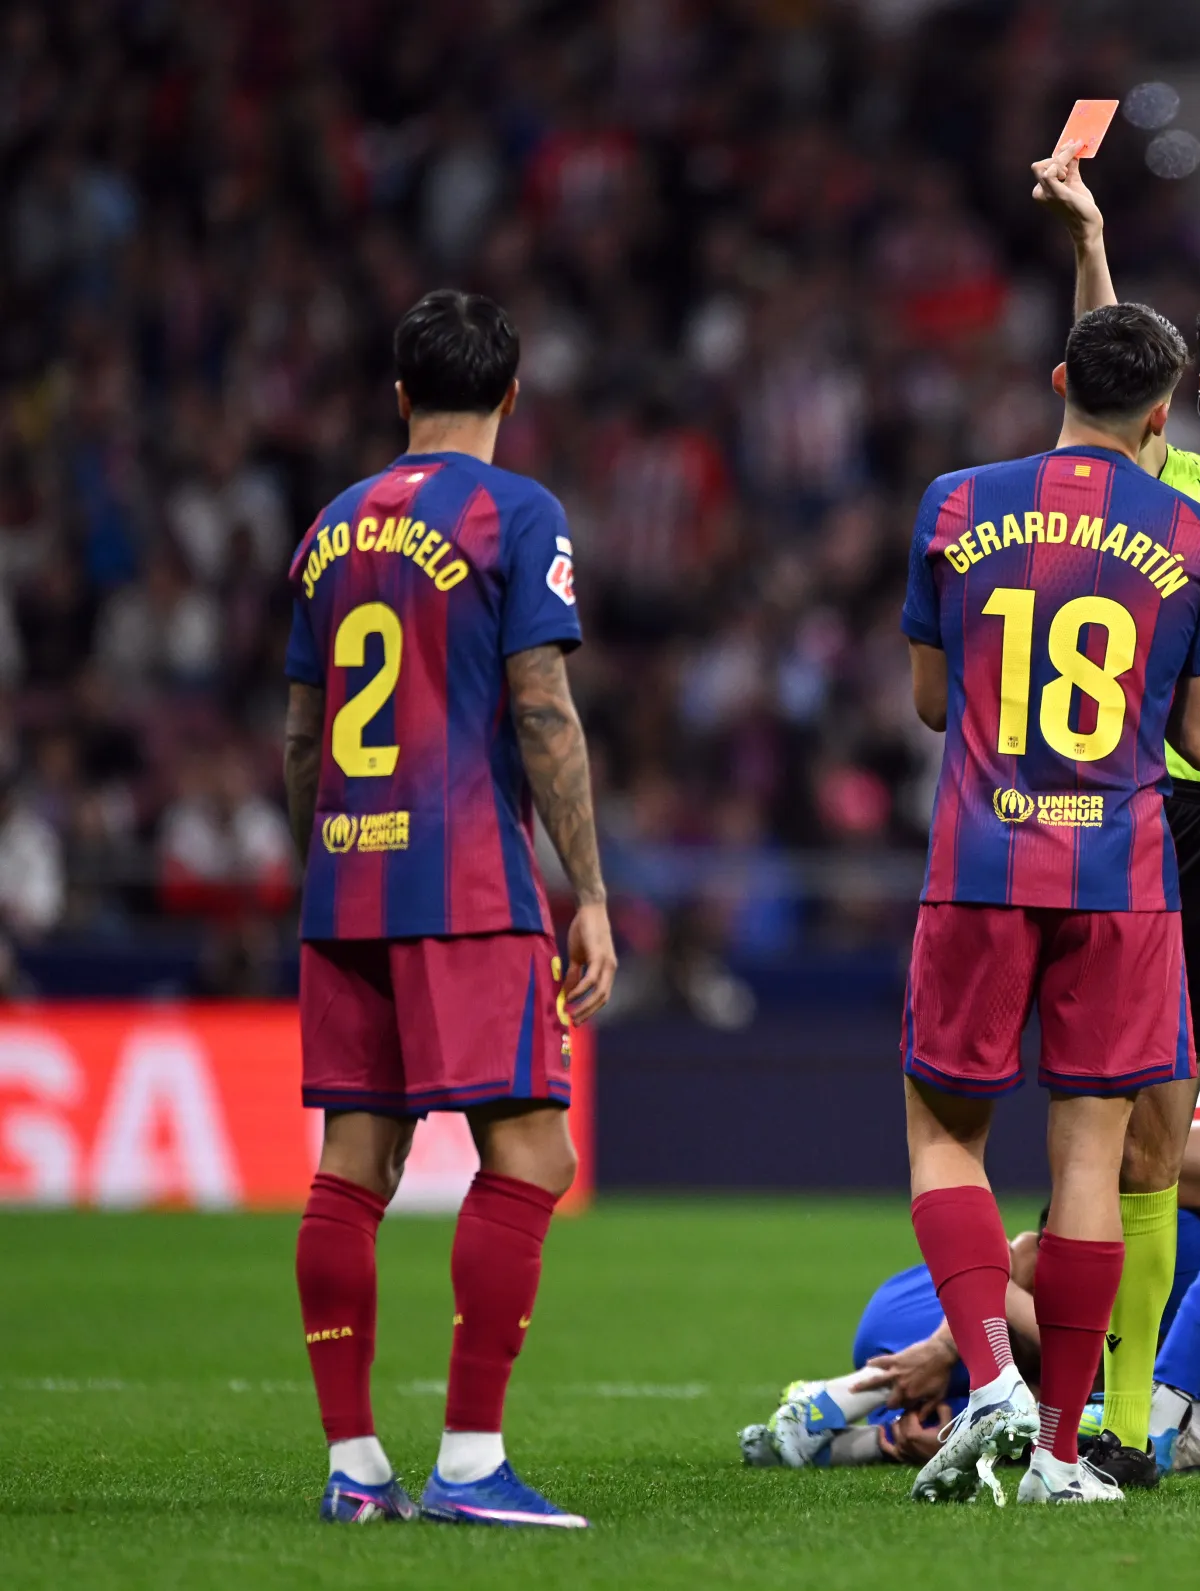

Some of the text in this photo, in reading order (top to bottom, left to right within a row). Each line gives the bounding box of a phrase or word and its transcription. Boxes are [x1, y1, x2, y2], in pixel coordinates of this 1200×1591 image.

[302, 516, 469, 598] JOÃO CANCELO
[943, 511, 1189, 599] GERARD MARTÍN
[332, 601, 403, 777] 2
[981, 587, 1137, 762] 18
[358, 828, 409, 846] ACNUR
[1037, 795, 1104, 809] UNHCR
[1037, 808, 1103, 821] ACNUR
